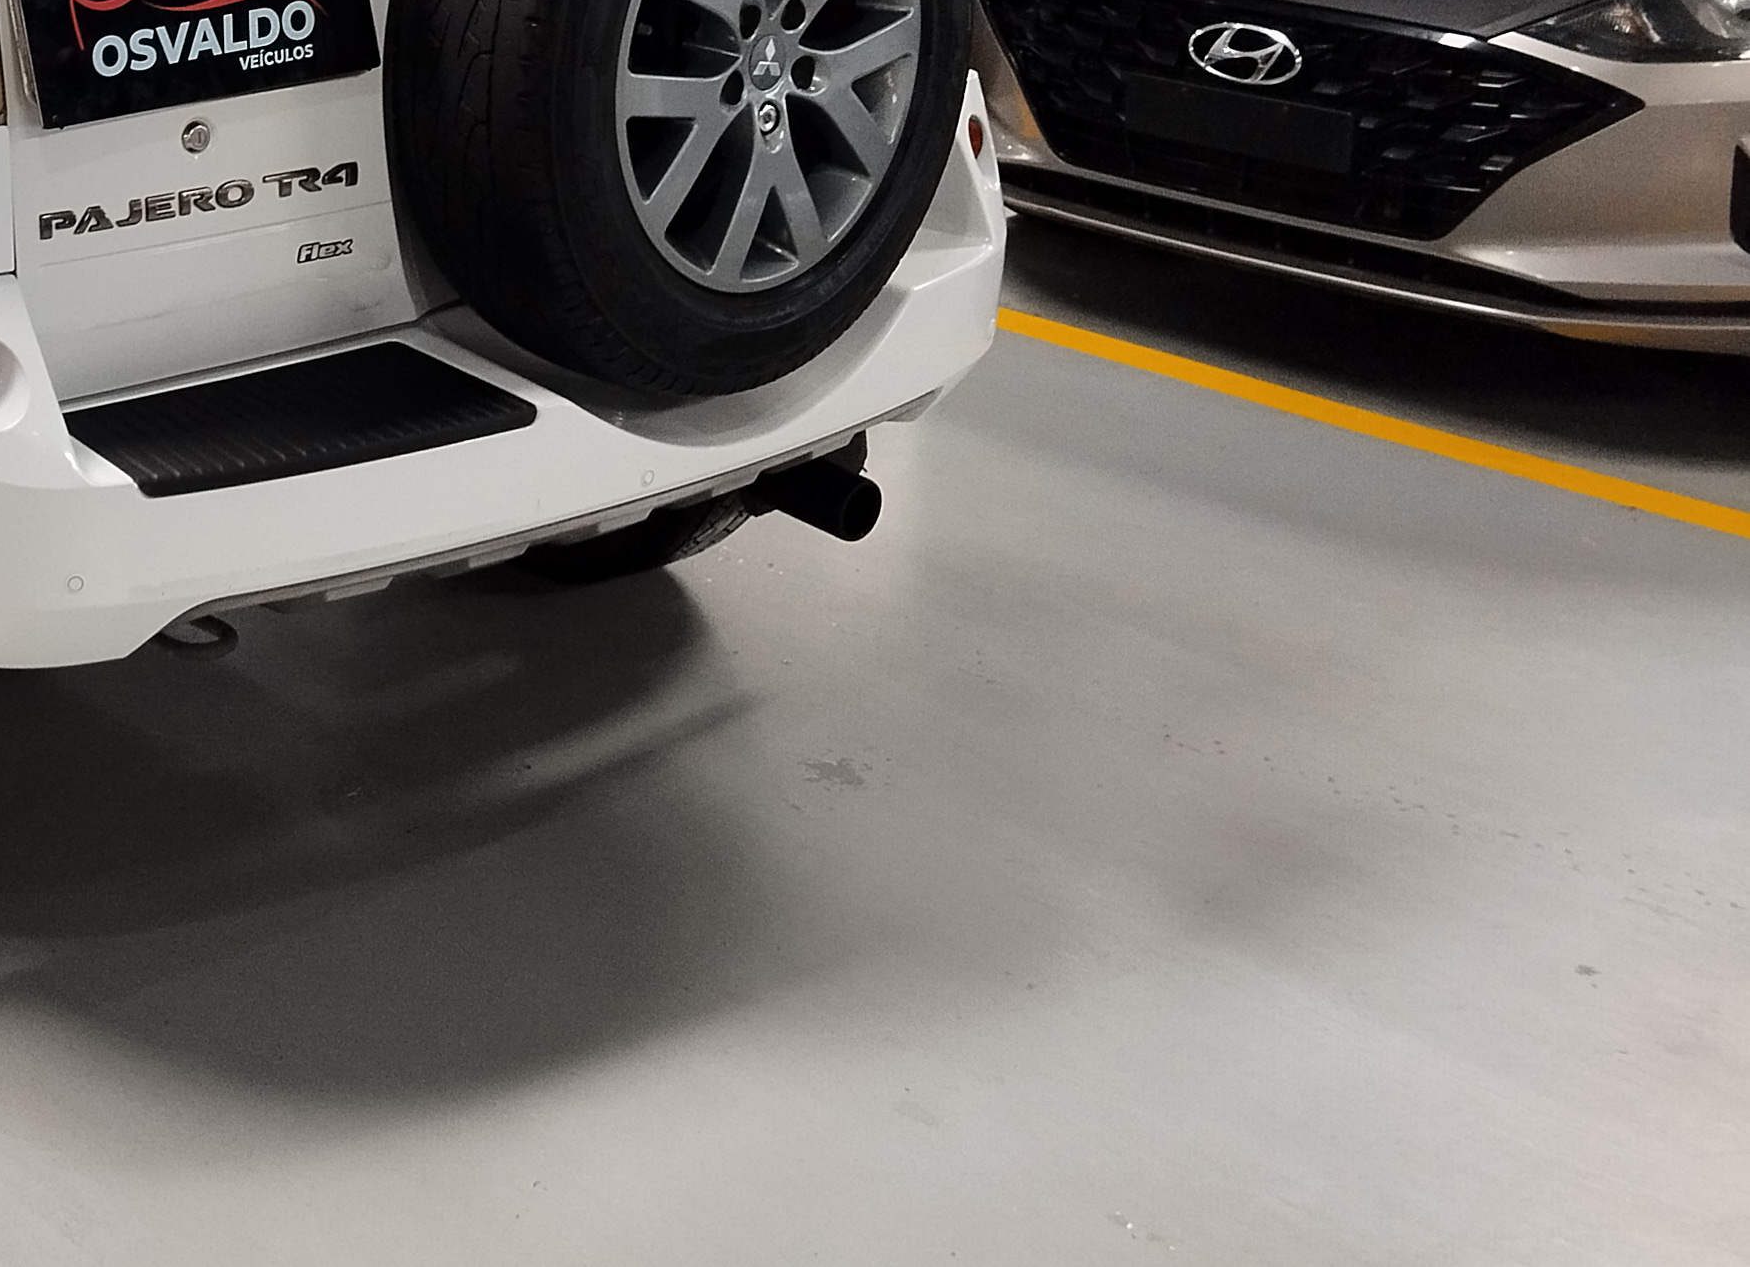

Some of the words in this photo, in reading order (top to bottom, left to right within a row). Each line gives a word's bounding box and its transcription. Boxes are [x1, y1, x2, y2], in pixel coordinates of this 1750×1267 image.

[92, 0, 315, 77] OSVALDO
[239, 43, 314, 71] VEÍCULOS
[39, 179, 255, 240] PAJERO
[262, 161, 359, 198] TR4
